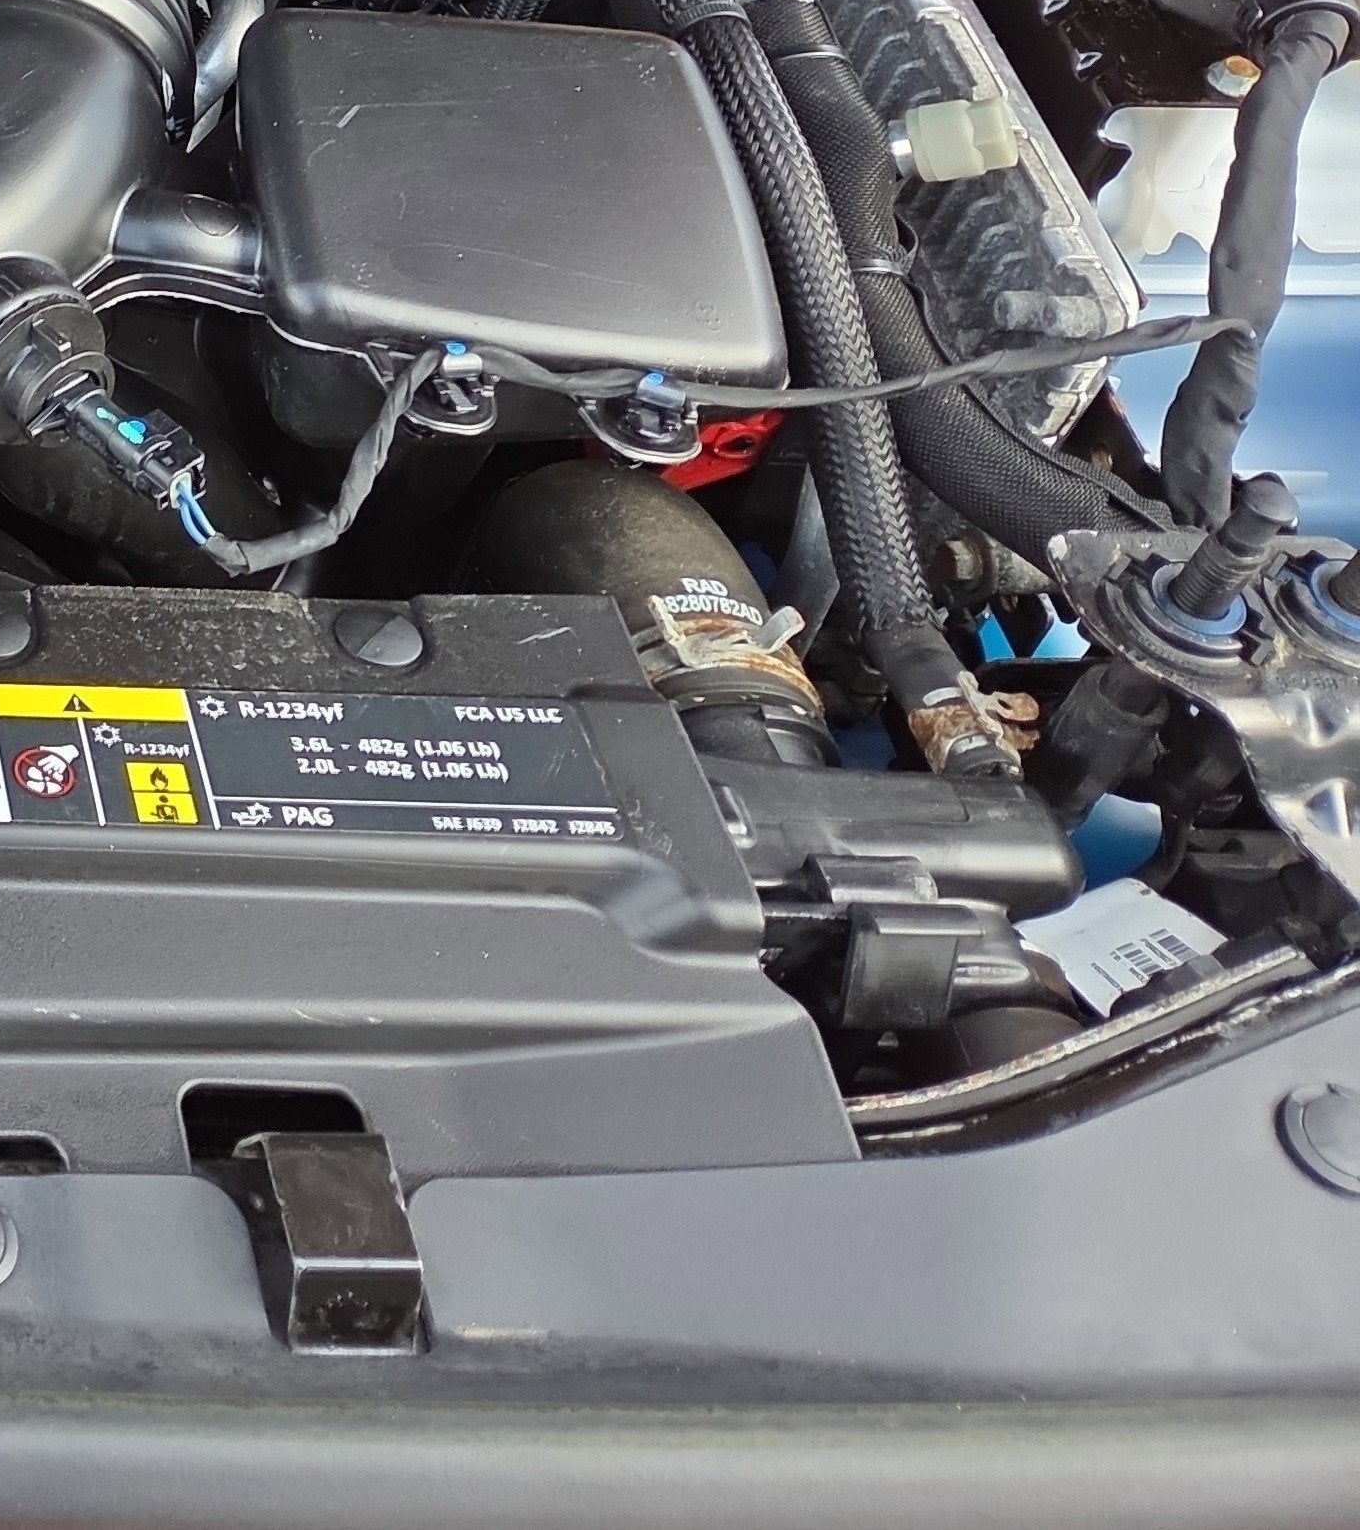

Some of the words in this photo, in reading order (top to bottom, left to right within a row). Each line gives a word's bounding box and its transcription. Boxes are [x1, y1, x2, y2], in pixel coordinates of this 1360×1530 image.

[680, 577, 729, 597] RAD
[664, 594, 764, 626] 8280782AD
[238, 700, 344, 724] R-1234yf
[454, 705, 495, 722] FCA
[496, 707, 527, 722] US
[529, 707, 564, 723] LLC
[290, 736, 335, 753] 3.6L
[358, 738, 408, 758] 482g
[414, 739, 466, 759] (1.06
[467, 741, 501, 761] Lb)
[297, 757, 342, 775] 2.0L
[365, 759, 416, 780] 482g
[421, 761, 474, 781] (1.06
[476, 762, 509, 784] Lb)
[281, 805, 335, 827] PAG
[432, 816, 465, 832] SAE
